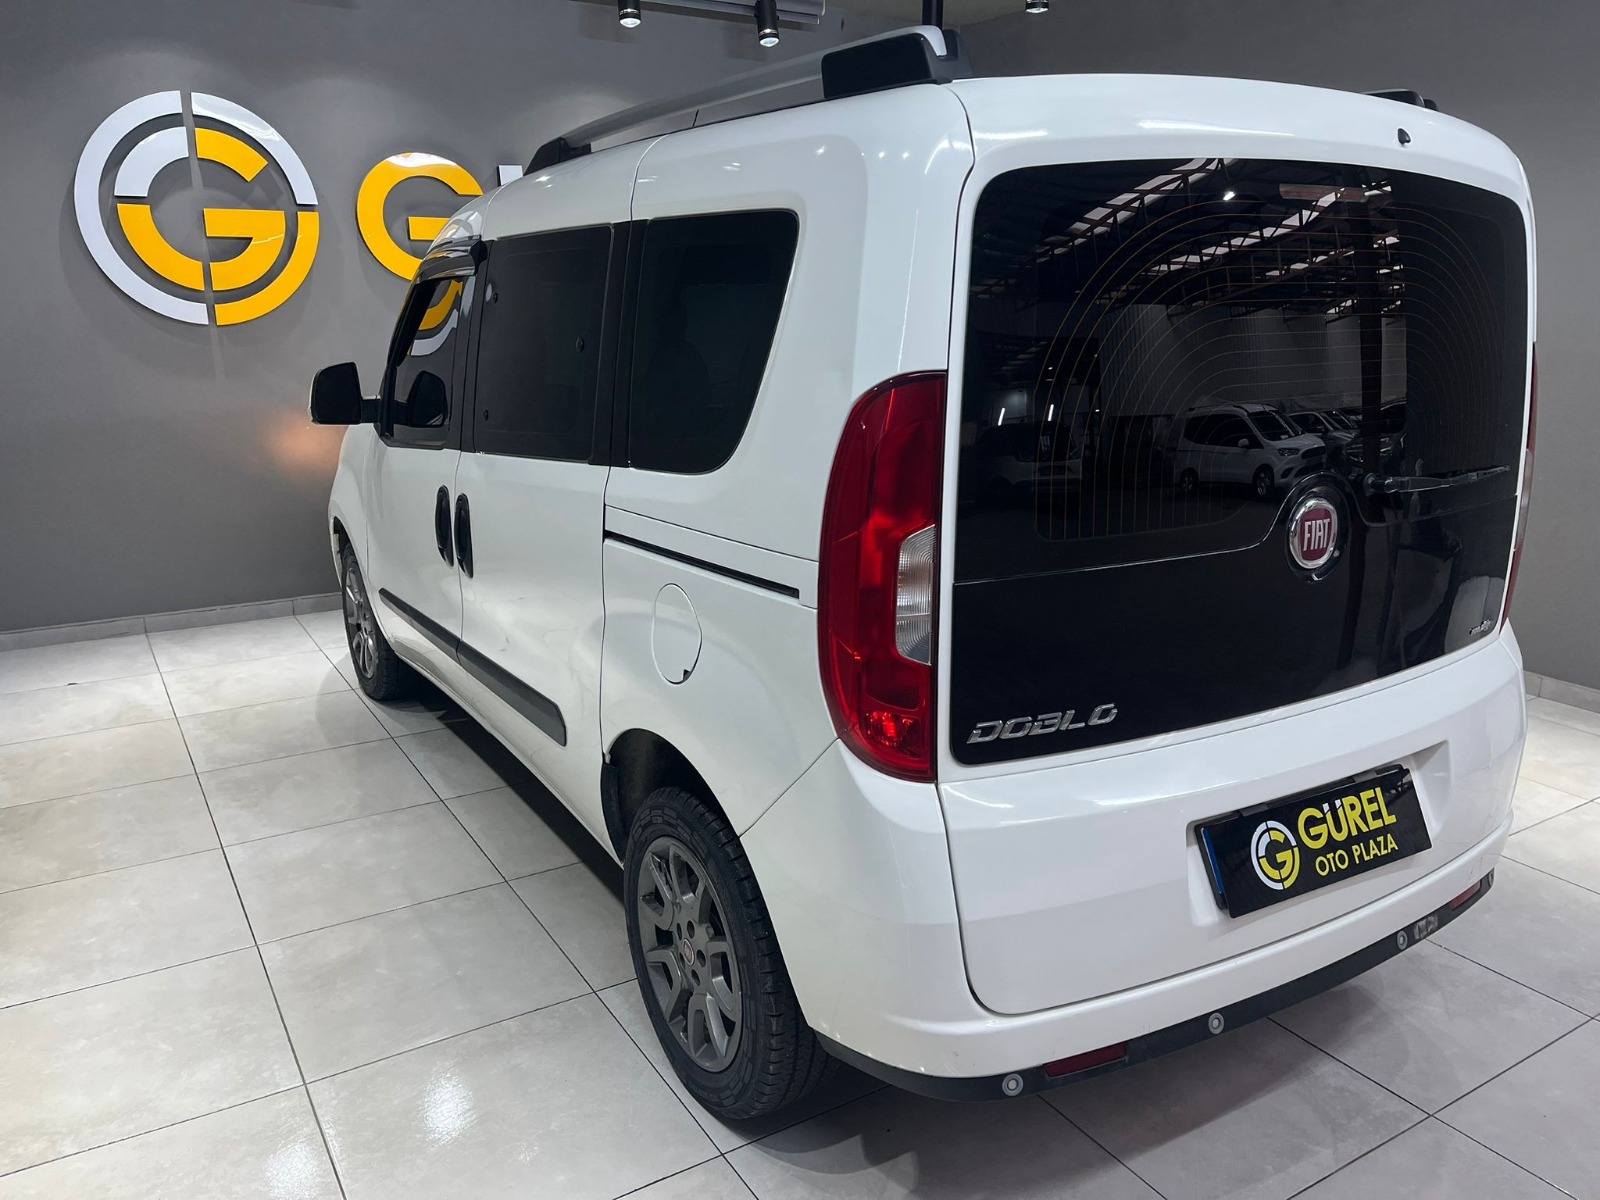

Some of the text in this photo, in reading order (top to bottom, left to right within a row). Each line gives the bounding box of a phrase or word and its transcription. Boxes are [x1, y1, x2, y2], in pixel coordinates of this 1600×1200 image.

[1303, 518, 1331, 551] FIAT
[966, 703, 1118, 744] DOBLO
[1297, 787, 1397, 849] GÜREL
[1315, 833, 1399, 876] OTO PLAZA
